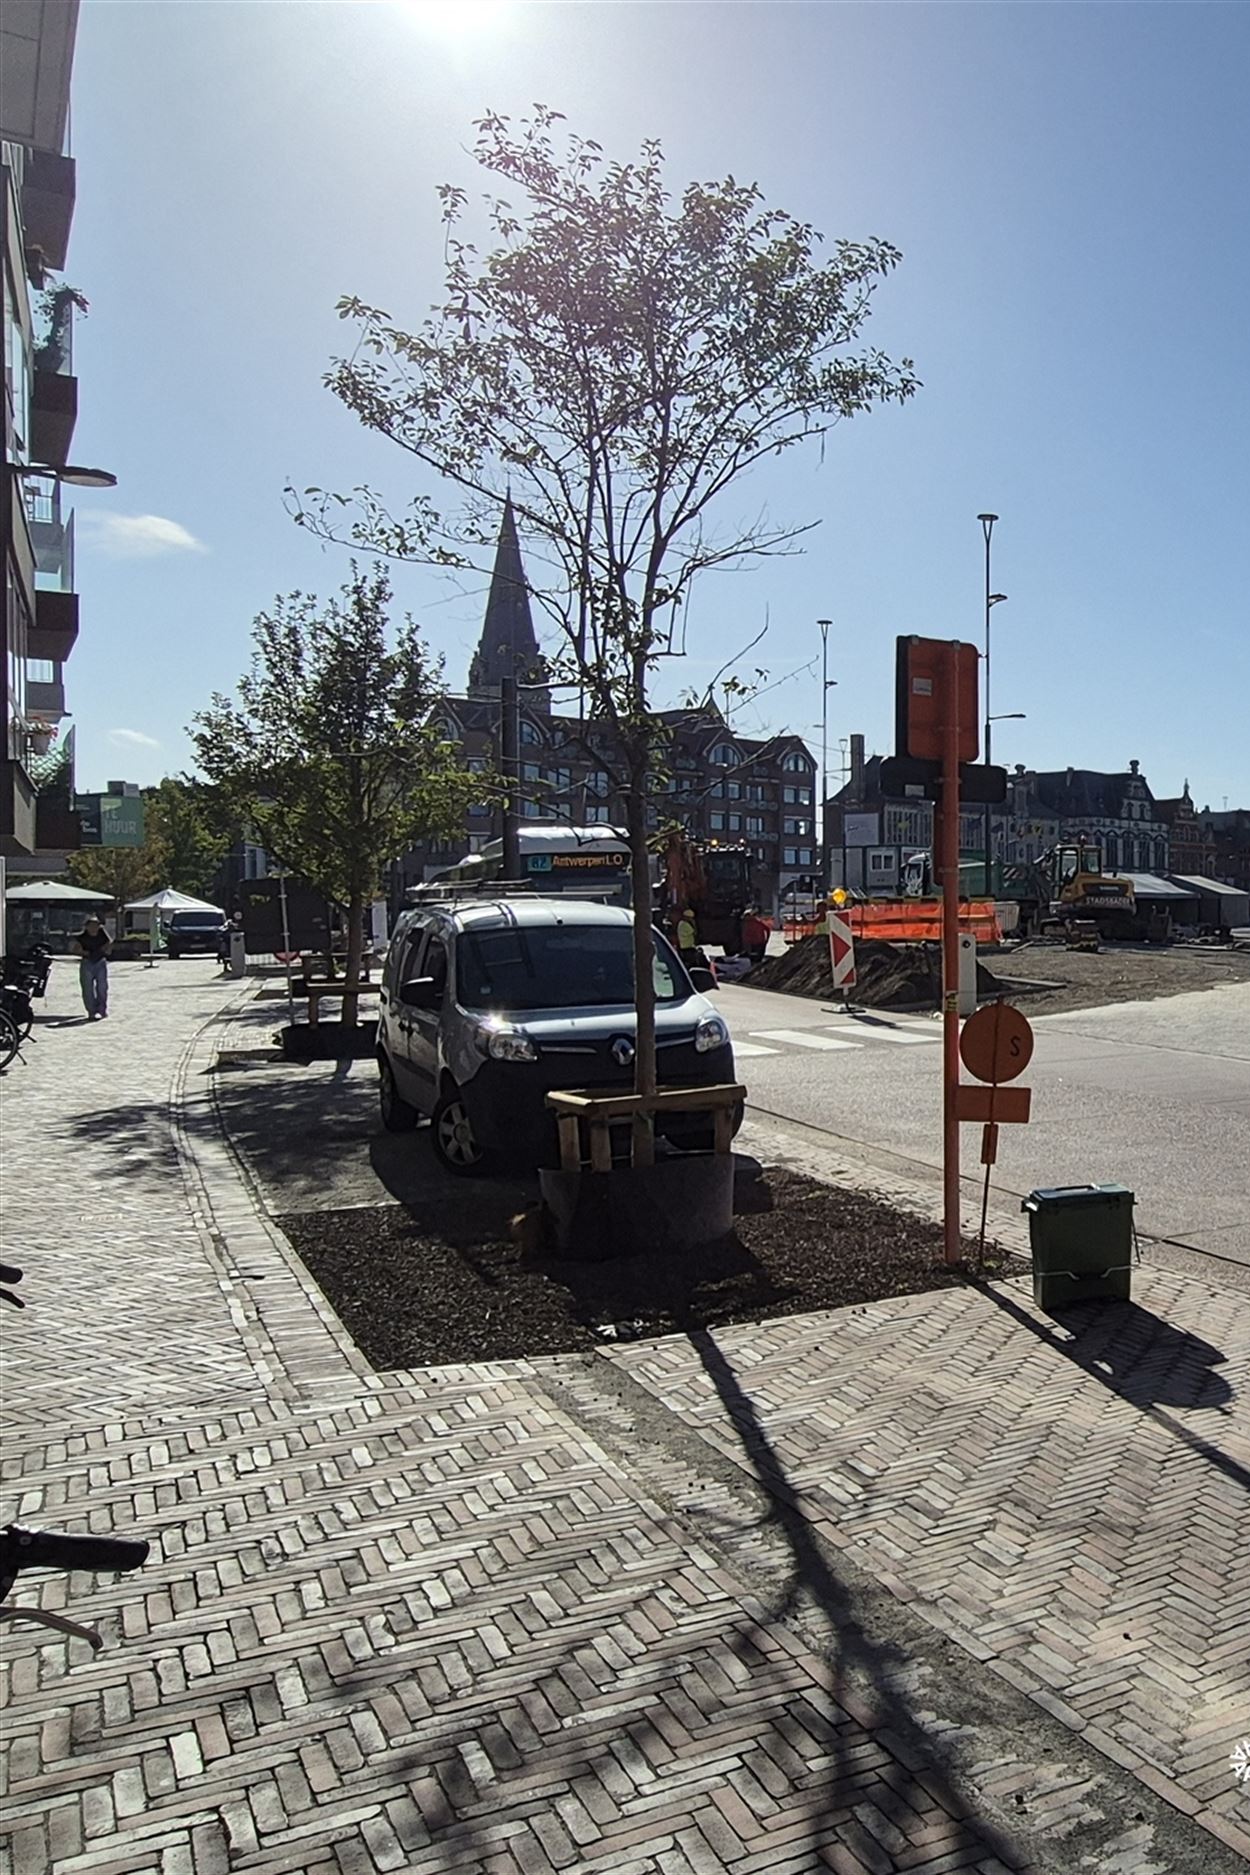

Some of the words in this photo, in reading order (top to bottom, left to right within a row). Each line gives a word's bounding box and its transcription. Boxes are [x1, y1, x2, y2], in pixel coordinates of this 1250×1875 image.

[105, 821, 137, 834] HUUR
[552, 855, 602, 868] Antwerpen
[1010, 1036, 1020, 1057] S
